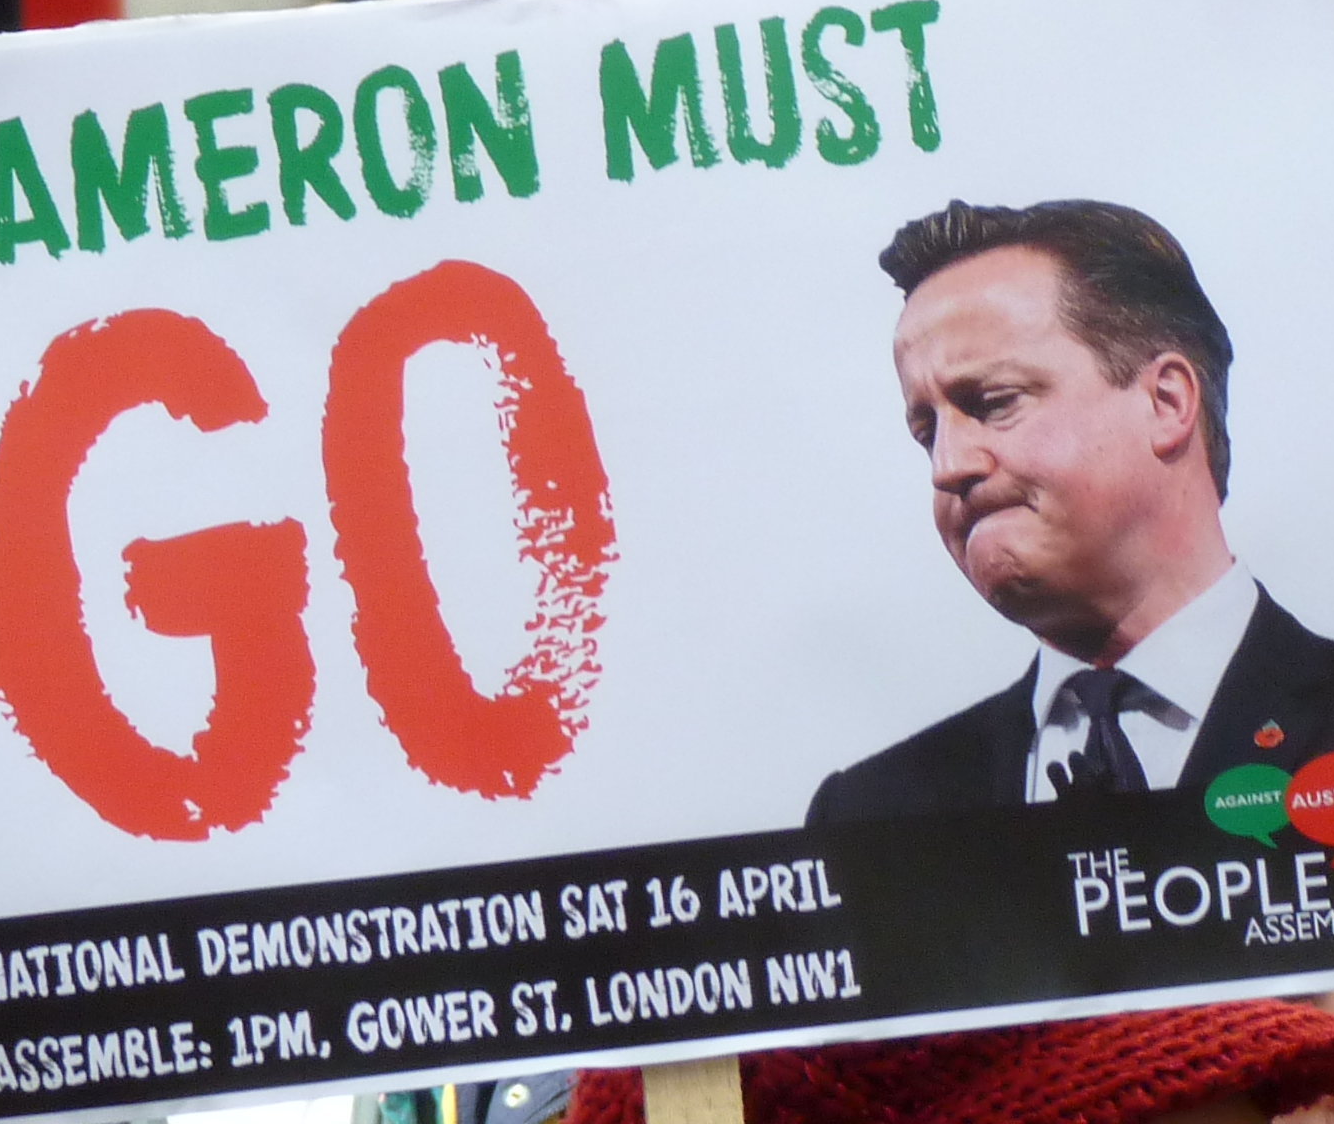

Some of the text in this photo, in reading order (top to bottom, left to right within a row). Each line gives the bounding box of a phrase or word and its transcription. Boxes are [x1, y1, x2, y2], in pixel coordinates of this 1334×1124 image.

[1214, 789, 1283, 810] AGAINST
[1067, 847, 1132, 879] THE
[196, 889, 547, 977] DEMONSTRATION
[559, 879, 628, 940] SAT
[645, 874, 700, 929] 16
[718, 858, 843, 919] APRIL
[227, 1008, 332, 1068] 1PM,
[346, 988, 499, 1054] GOWER
[510, 979, 573, 1038] ST,
[585, 959, 754, 1027] LONDON
[765, 948, 863, 1006] NW1
